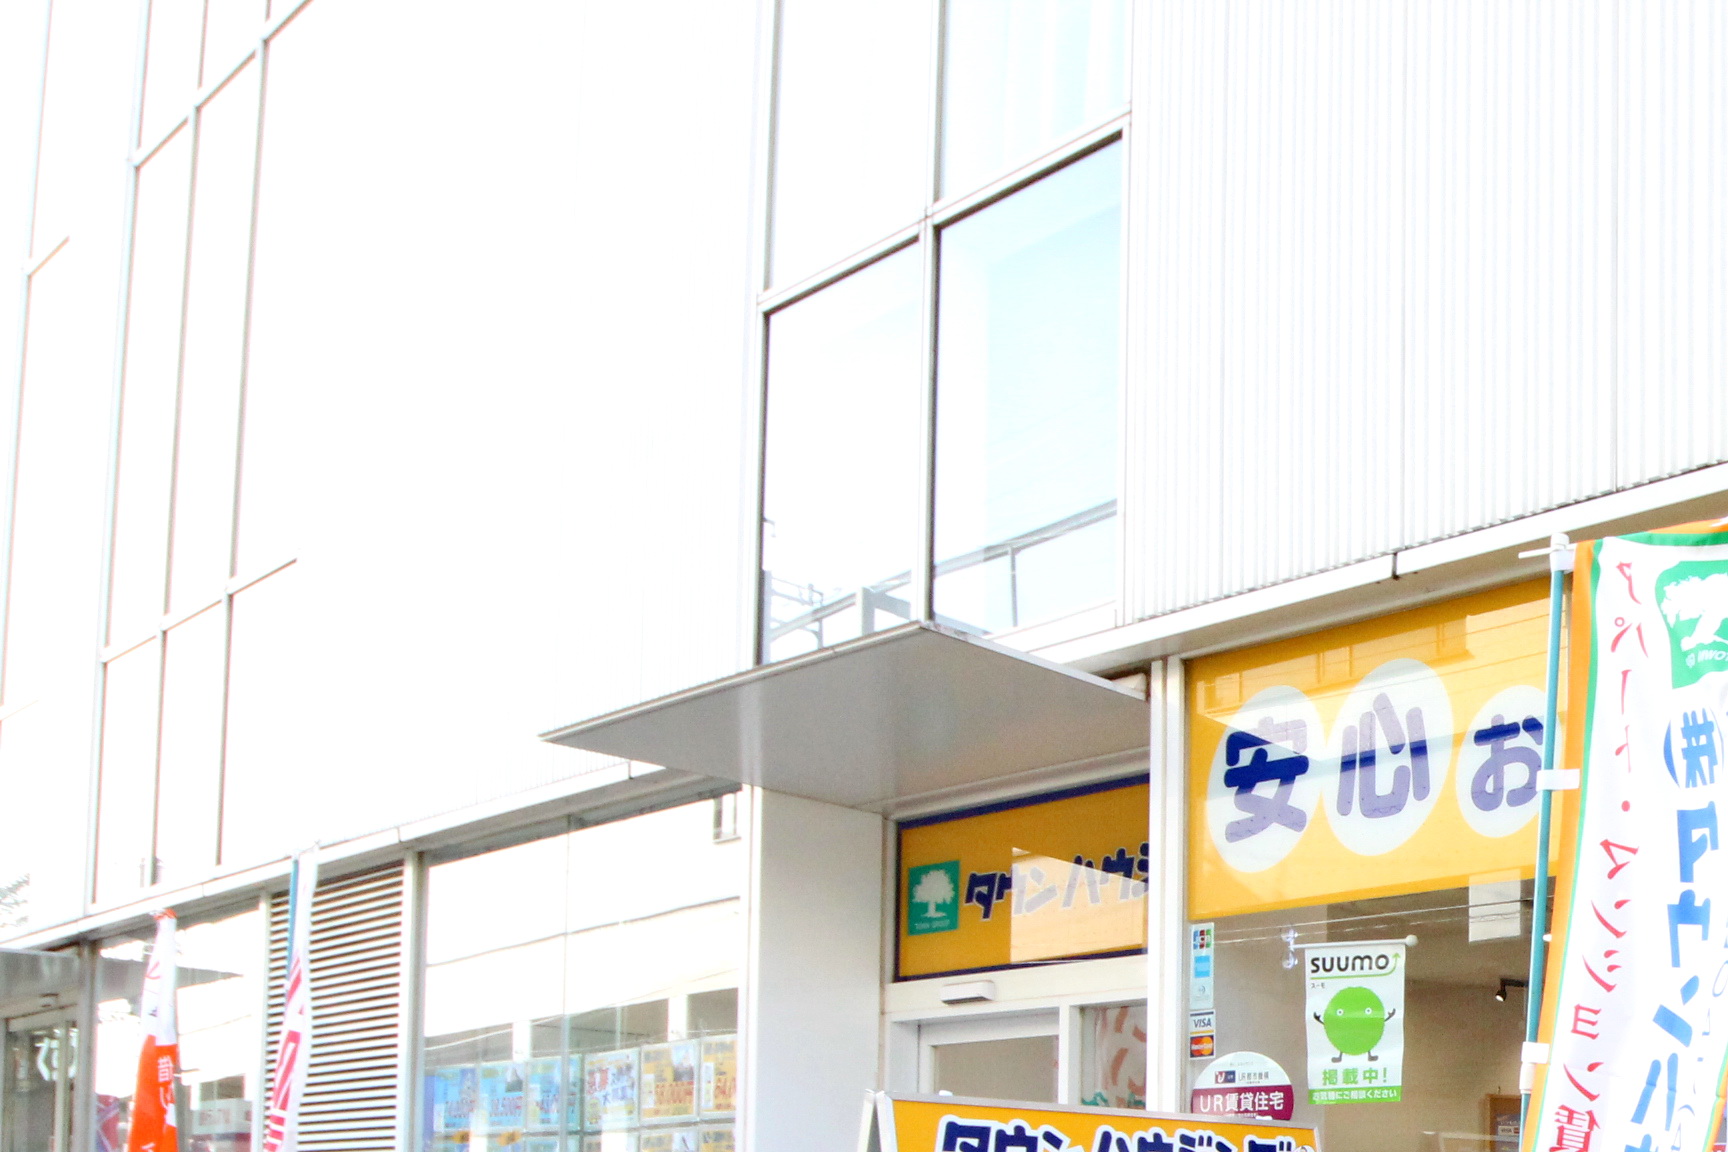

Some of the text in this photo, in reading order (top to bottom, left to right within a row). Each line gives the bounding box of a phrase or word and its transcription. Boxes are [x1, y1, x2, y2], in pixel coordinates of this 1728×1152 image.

[1193, 1017, 1213, 1029] VISA
[1200, 1092, 1284, 1114] UR賃貸住宅
